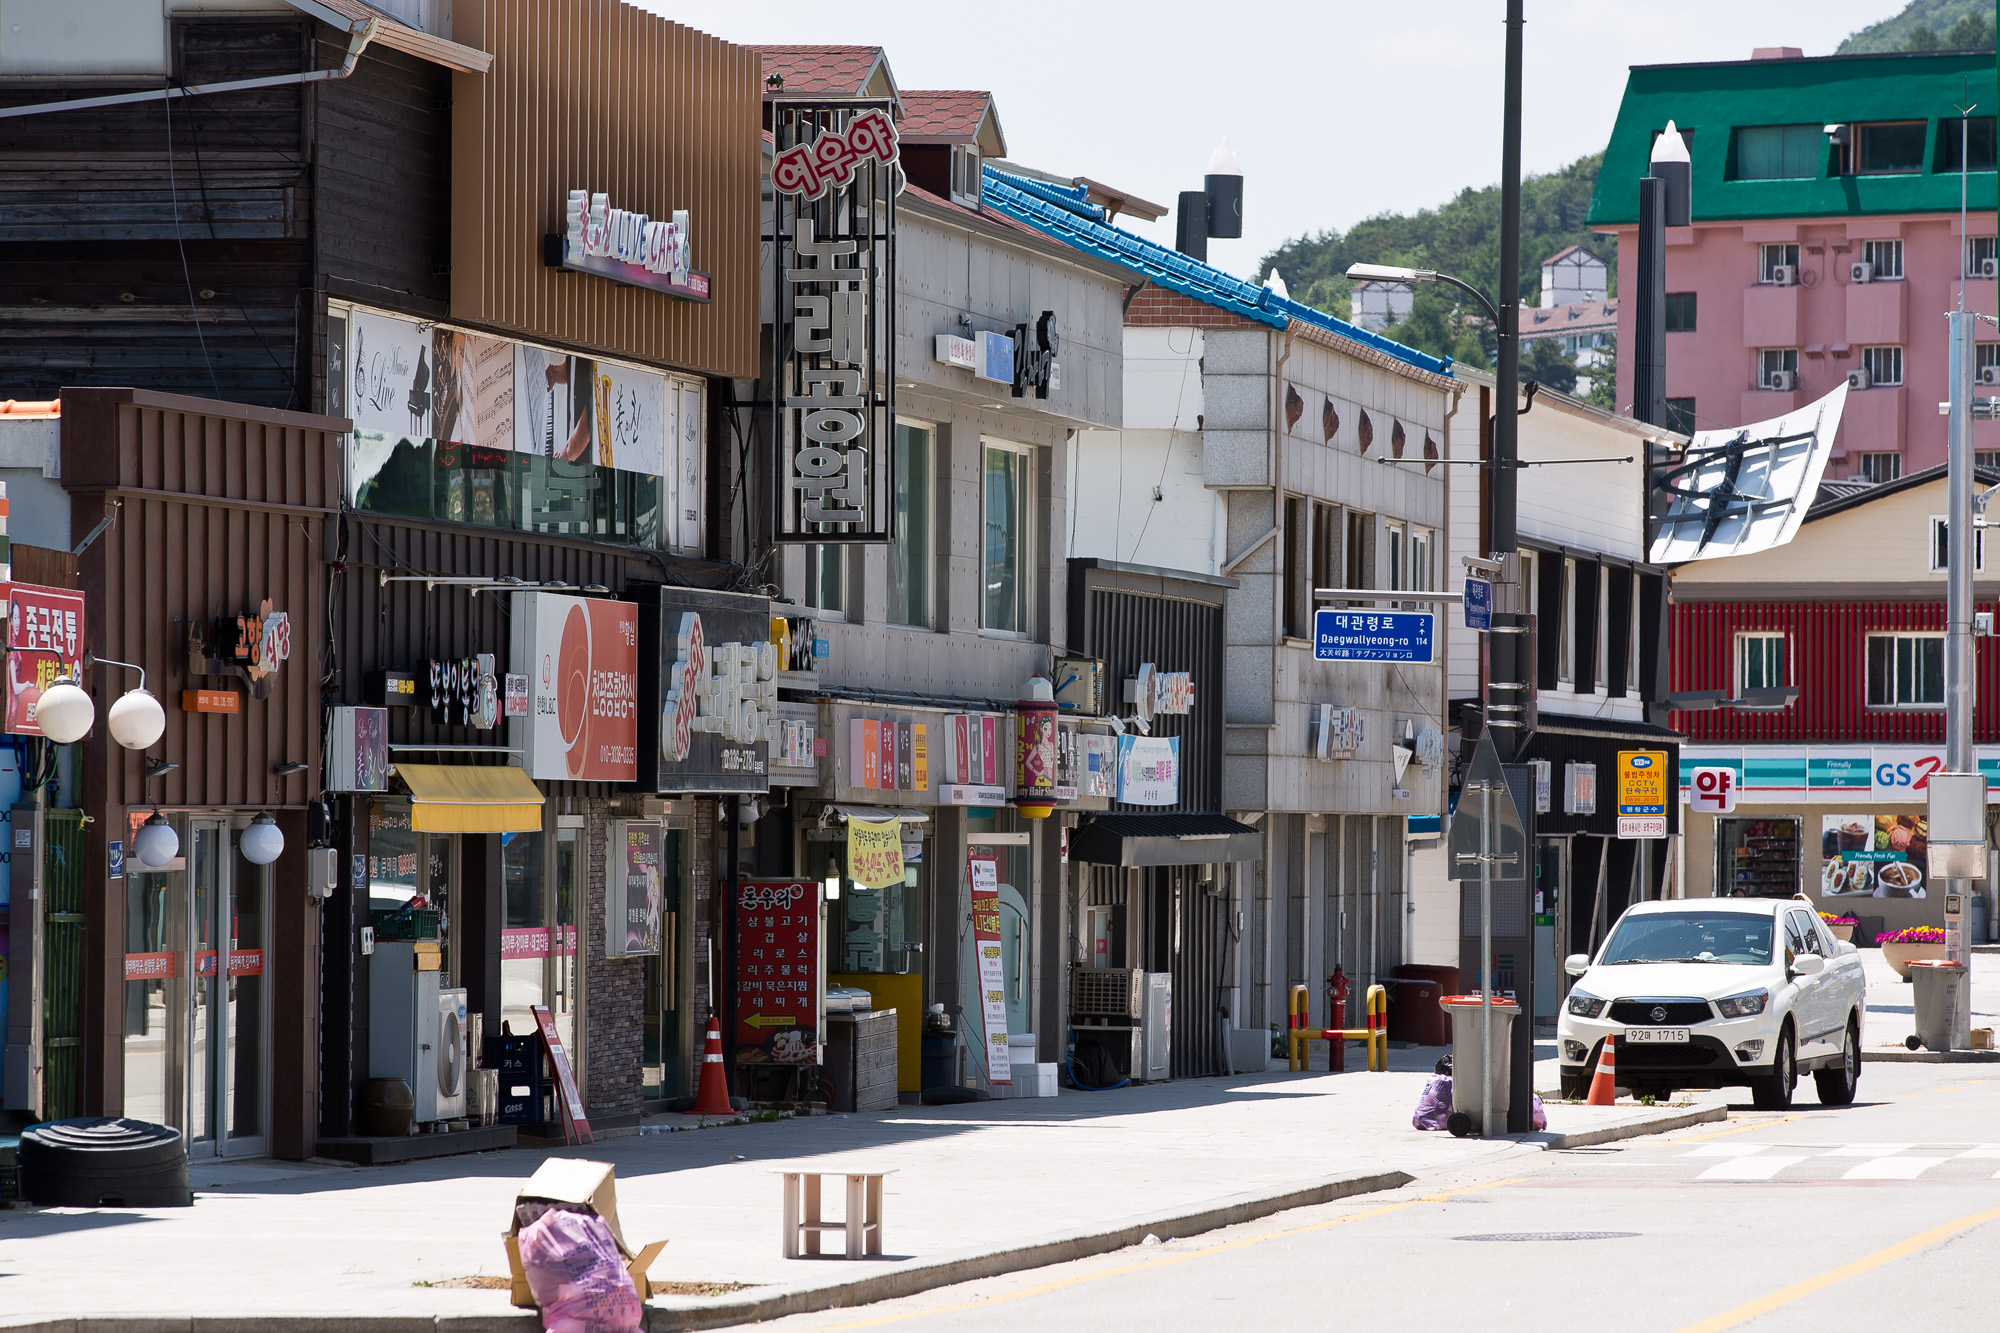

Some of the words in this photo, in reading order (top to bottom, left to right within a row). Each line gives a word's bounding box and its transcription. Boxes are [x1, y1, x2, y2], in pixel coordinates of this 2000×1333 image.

[775, 113, 894, 196] 여우야
[617, 211, 648, 264] LIVE
[650, 222, 681, 272] CAFE
[787, 219, 864, 522] 노래공원
[369, 351, 396, 412] Live
[1336, 615, 1394, 631] 대관령로
[1419, 618, 1425, 627] 2
[26, 605, 77, 657] 중국전통
[625, 620, 635, 647] 황실
[1321, 634, 1409, 647] Daegwallyeong-ro
[1416, 637, 1428, 645] 114
[430, 658, 481, 727] 또봉이통닭
[675, 617, 704, 758] 여우야
[537, 696, 556, 715] 한화L&C
[1827, 761, 1851, 769] Friendly
[1624, 771, 1660, 779] 불법주정차
[1876, 756, 1947, 791] GS2
[1833, 778, 1845, 786] Fun
[1029, 787, 1044, 798] Hair
[1697, 772, 1730, 809] 약
[1855, 852, 1872, 860] Friendly
[1631, 1030, 1651, 1041] 92마
[1657, 1031, 1684, 1041] 1715
[504, 1059, 522, 1068] 카스
[505, 1103, 523, 1114] Cass
